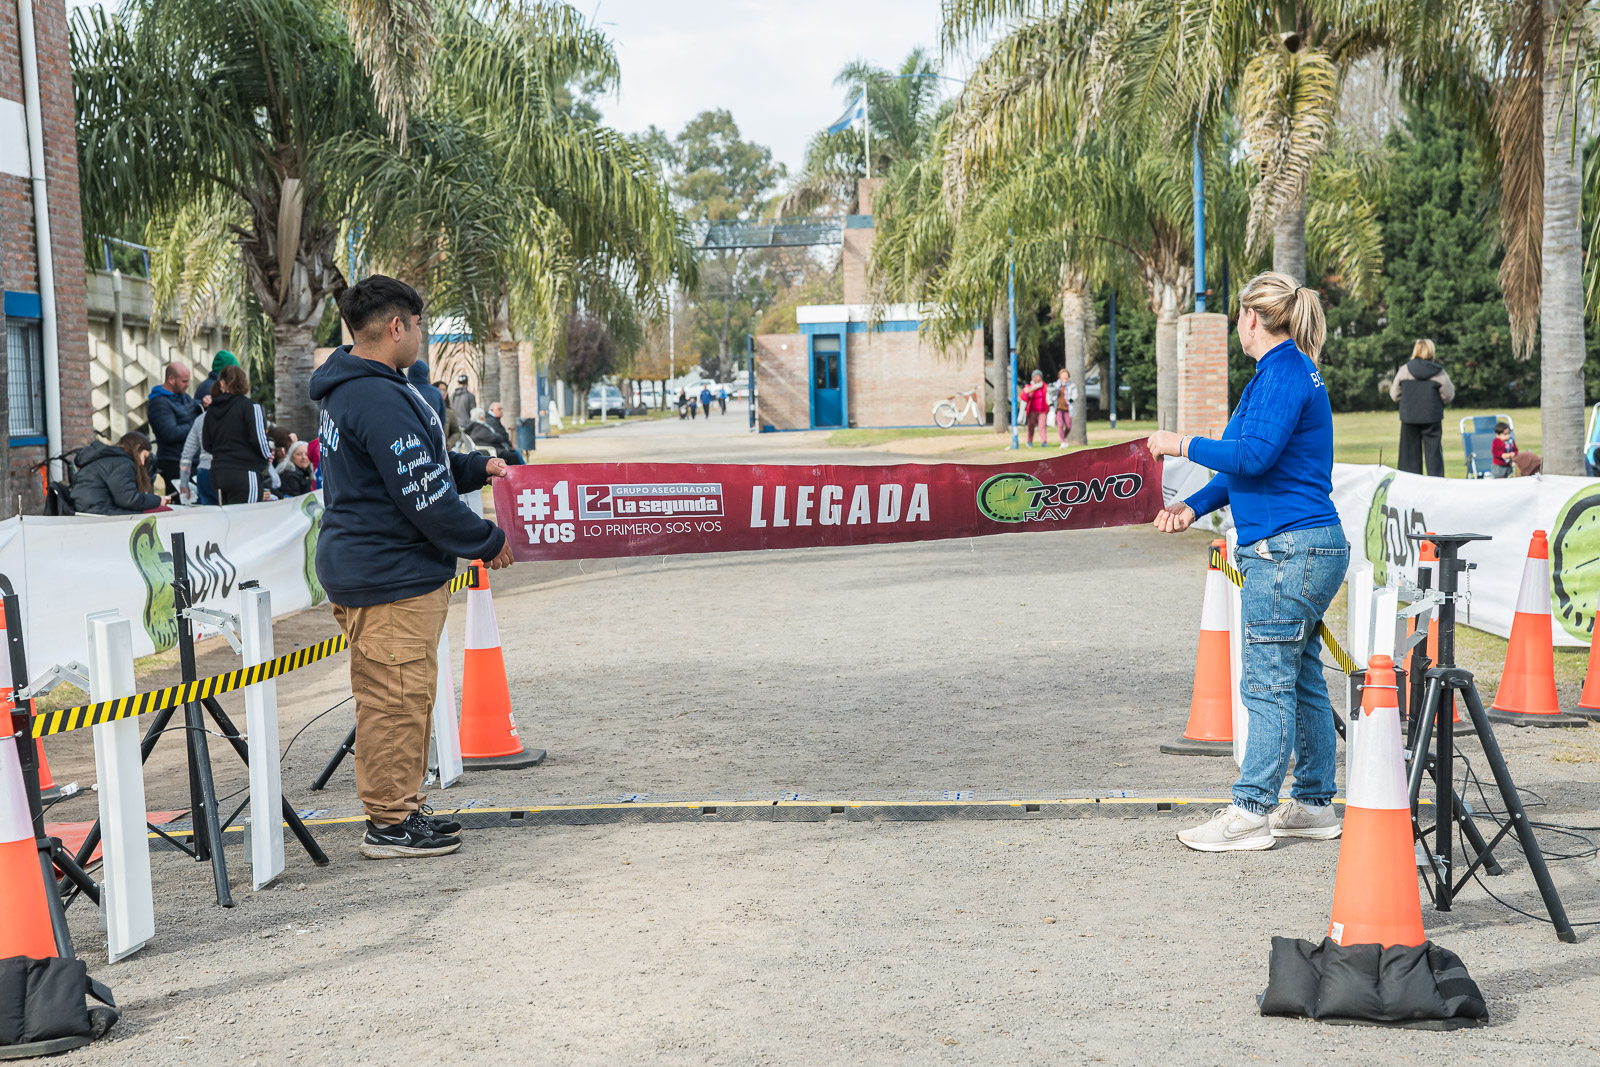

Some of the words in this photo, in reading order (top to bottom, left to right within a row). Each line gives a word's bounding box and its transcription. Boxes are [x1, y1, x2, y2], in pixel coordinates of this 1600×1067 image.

[390, 437, 405, 456] El
[651, 486, 717, 494] ASEGURADOR
[415, 494, 429, 512] del
[516, 480, 574, 521] #1
[639, 497, 718, 515] segunda
[750, 484, 931, 528] LLEGADA
[1023, 507, 1073, 522] RAV
[524, 522, 575, 544] VOS
[583, 525, 602, 537] LO
[606, 522, 662, 536] PRIMERO
[666, 522, 692, 533] SOS
[696, 520, 722, 532] VOS
